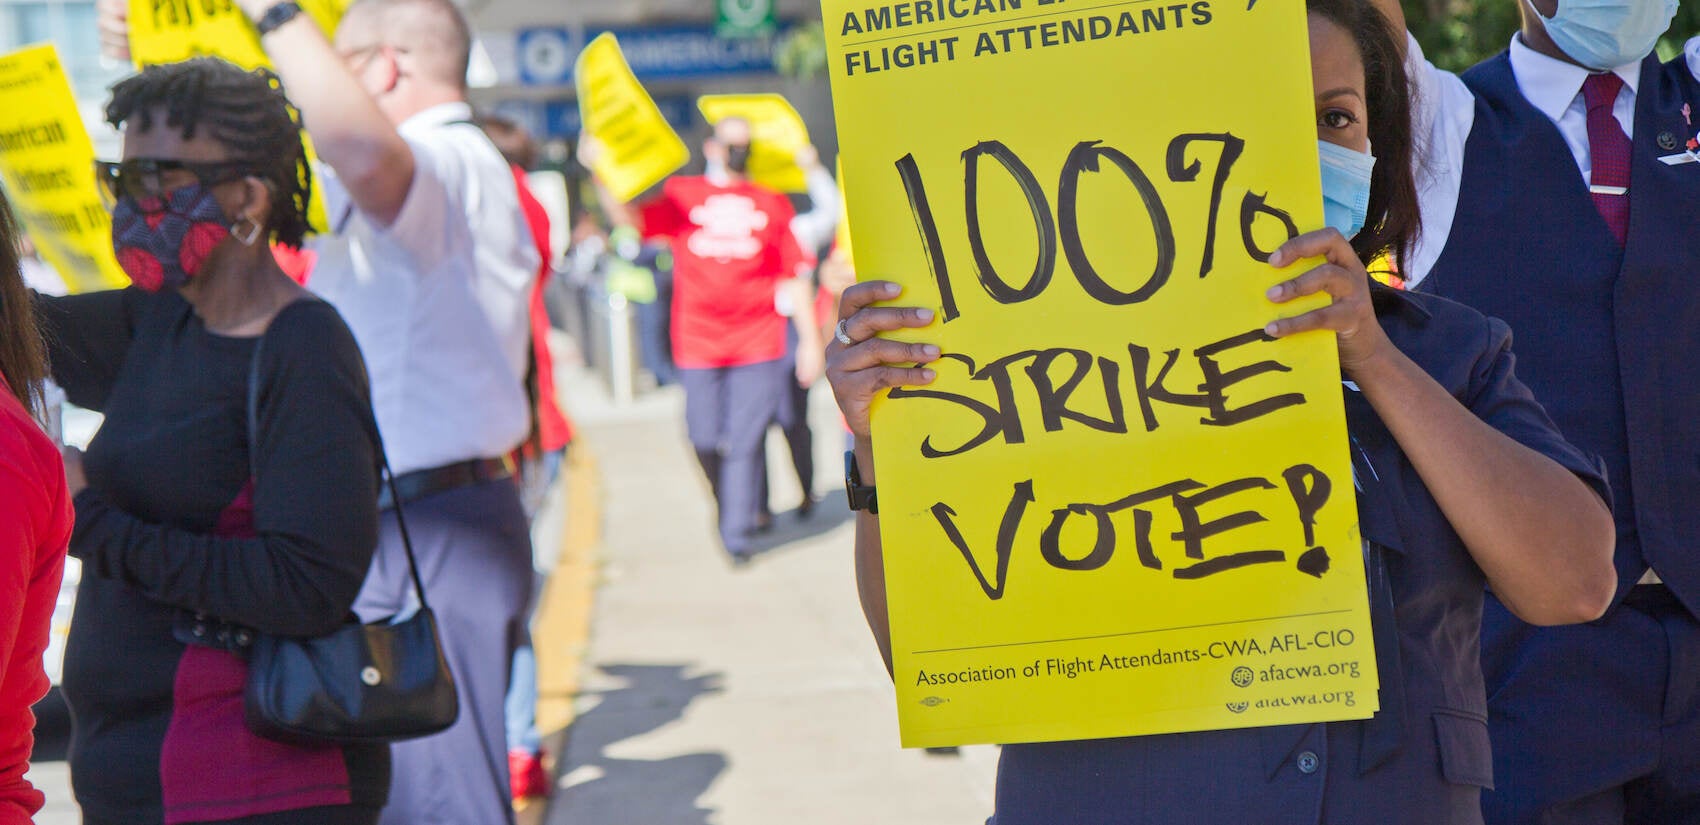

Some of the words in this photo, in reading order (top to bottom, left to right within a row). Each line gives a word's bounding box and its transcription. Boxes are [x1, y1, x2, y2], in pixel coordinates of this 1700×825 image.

[845, 37, 959, 76] FLIGHT
[974, 2, 1213, 57] ATTENDANTS
[895, 132, 1299, 323] 100%
[888, 328, 1306, 458] STRIKE
[930, 463, 1332, 600] VOTE!
[916, 665, 1016, 687] Association
[1023, 660, 1040, 678] of
[1046, 656, 1095, 679] Flight
[1269, 628, 1355, 654] AFL-CIO
[1259, 660, 1361, 683] afacwa.org
